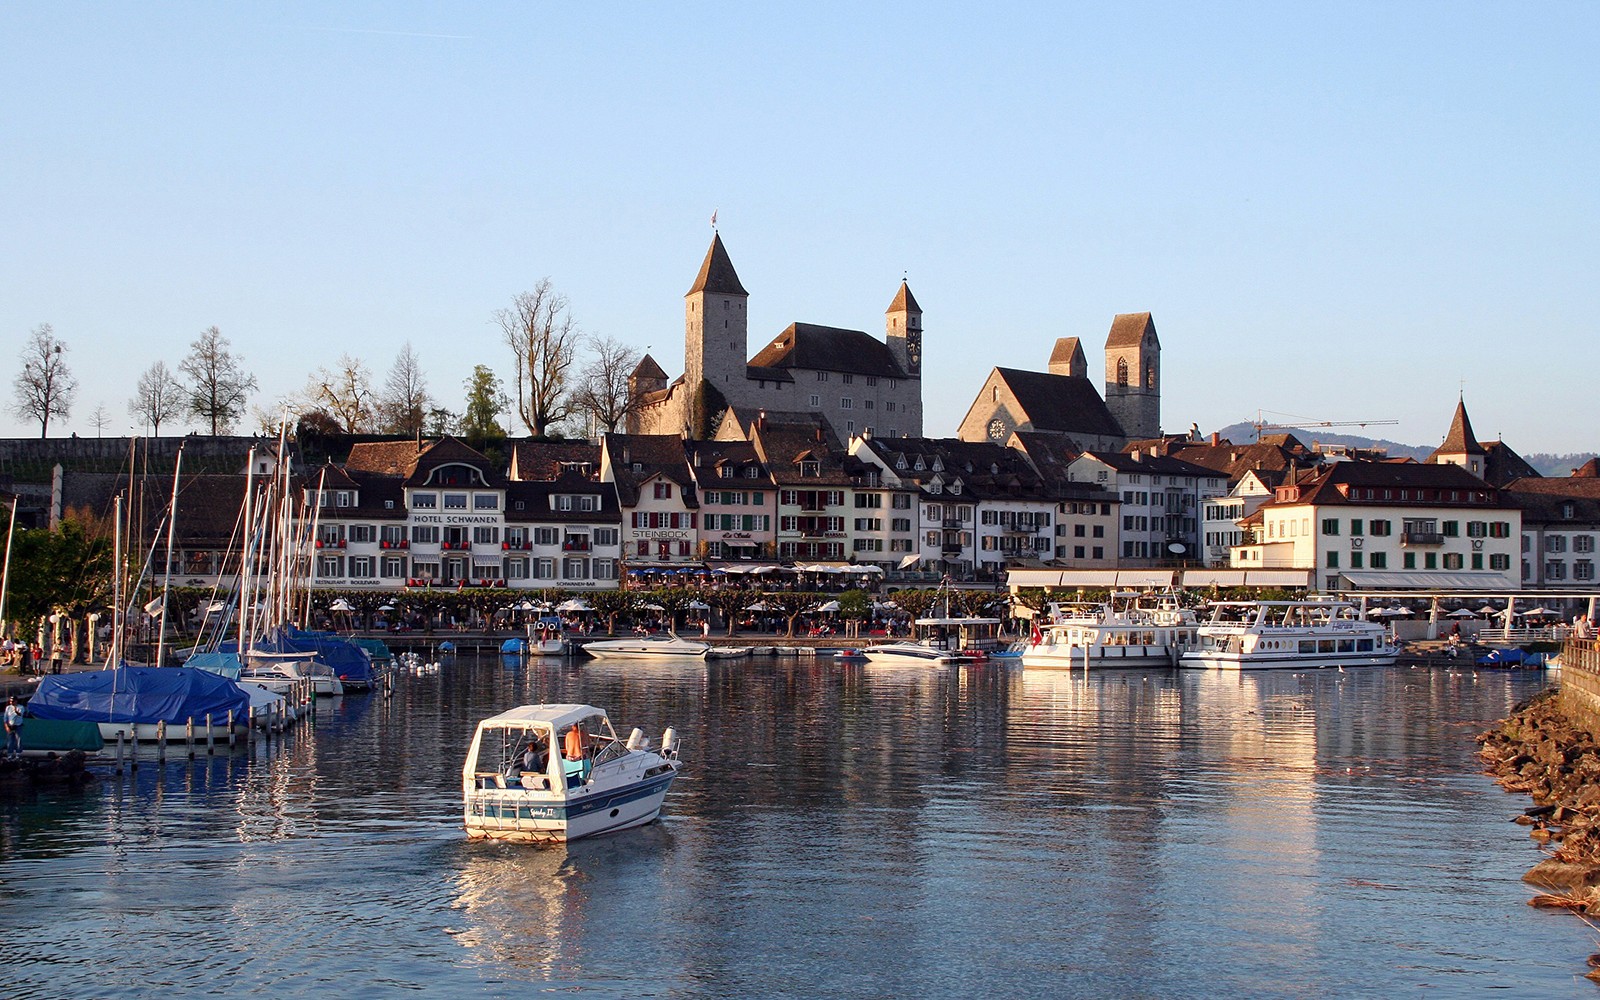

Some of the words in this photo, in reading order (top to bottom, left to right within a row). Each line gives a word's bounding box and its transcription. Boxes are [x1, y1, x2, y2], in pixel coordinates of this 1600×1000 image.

[414, 515, 442, 523] HOTEL
[446, 515, 498, 524] SCHWANEN
[632, 530, 688, 538] STEINBOCK
